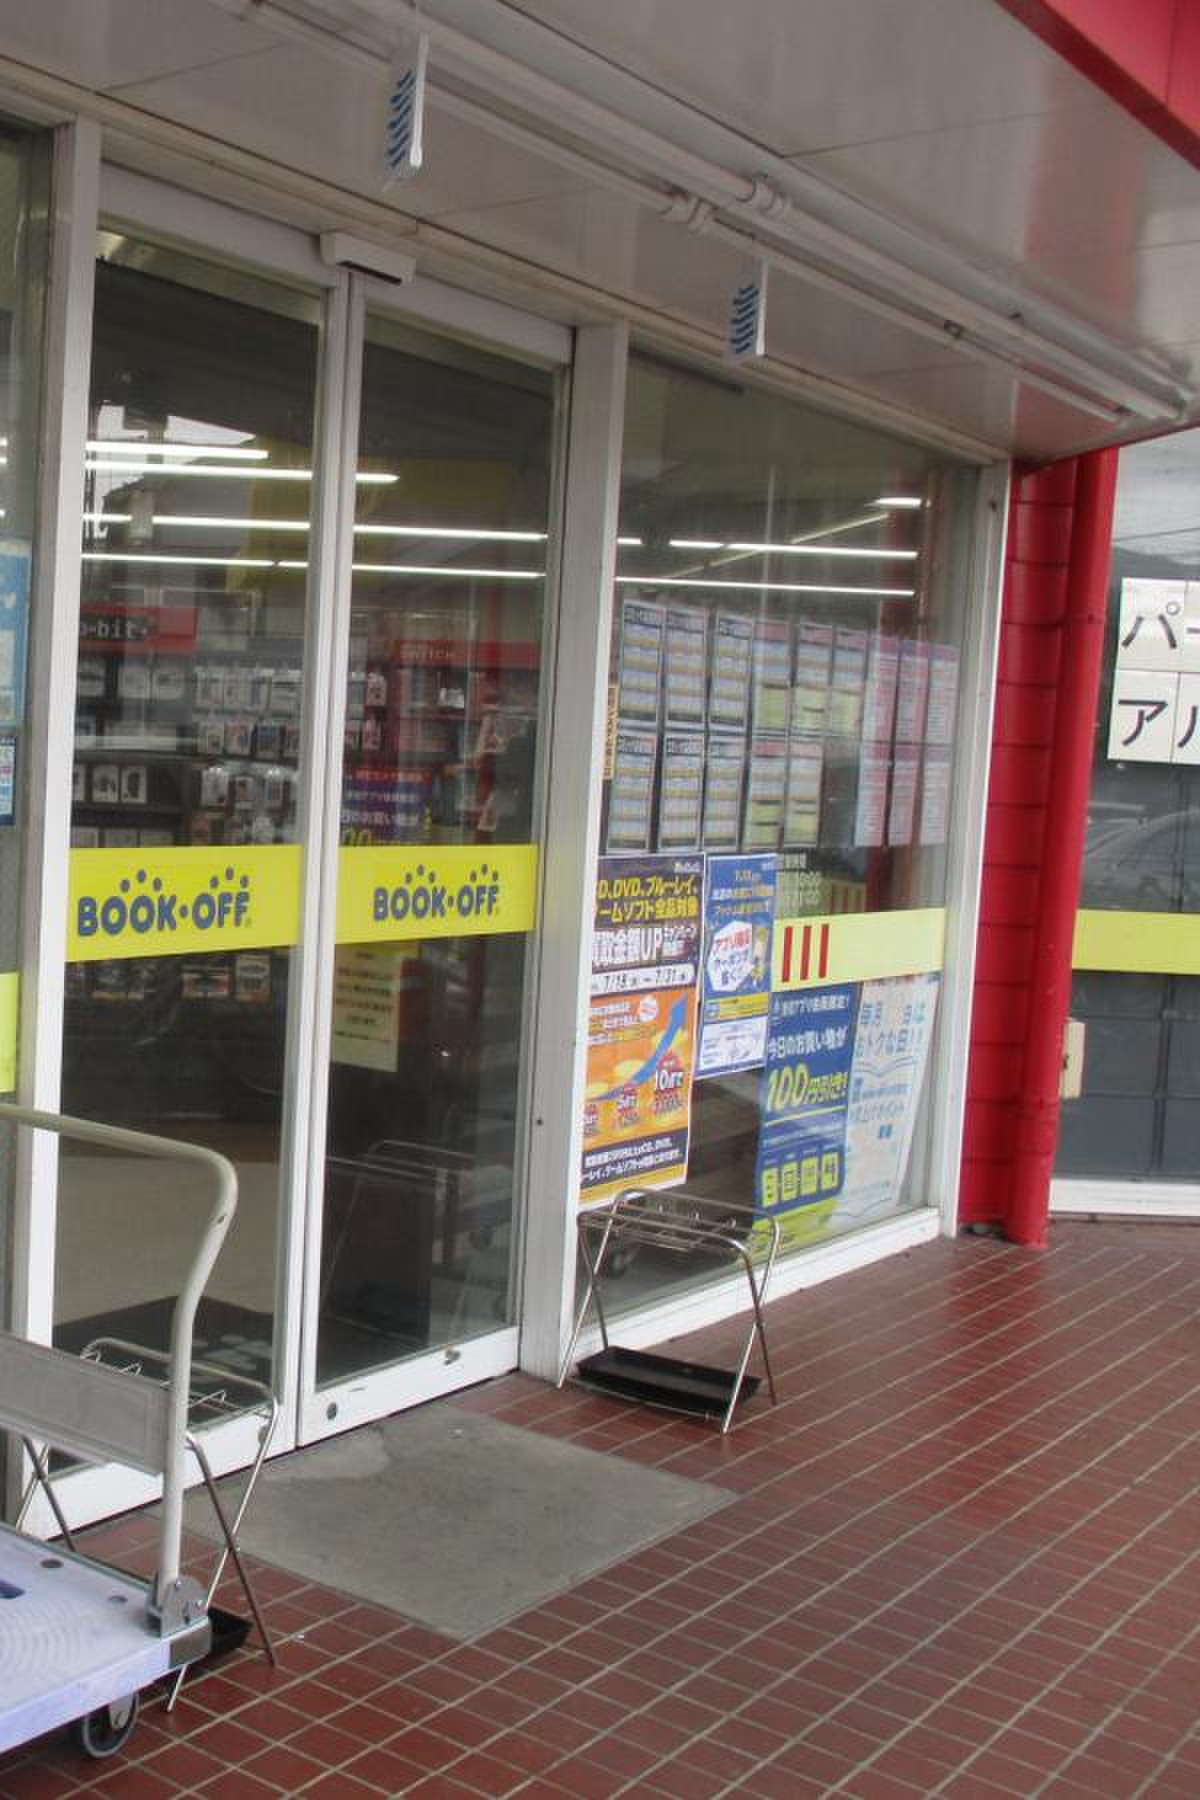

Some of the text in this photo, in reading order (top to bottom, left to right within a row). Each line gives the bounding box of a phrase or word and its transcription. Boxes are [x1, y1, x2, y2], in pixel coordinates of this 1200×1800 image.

[598, 875, 698, 899] D、DVD、ブルーレイ、
[597, 896, 698, 924] ームソフト全品対象
